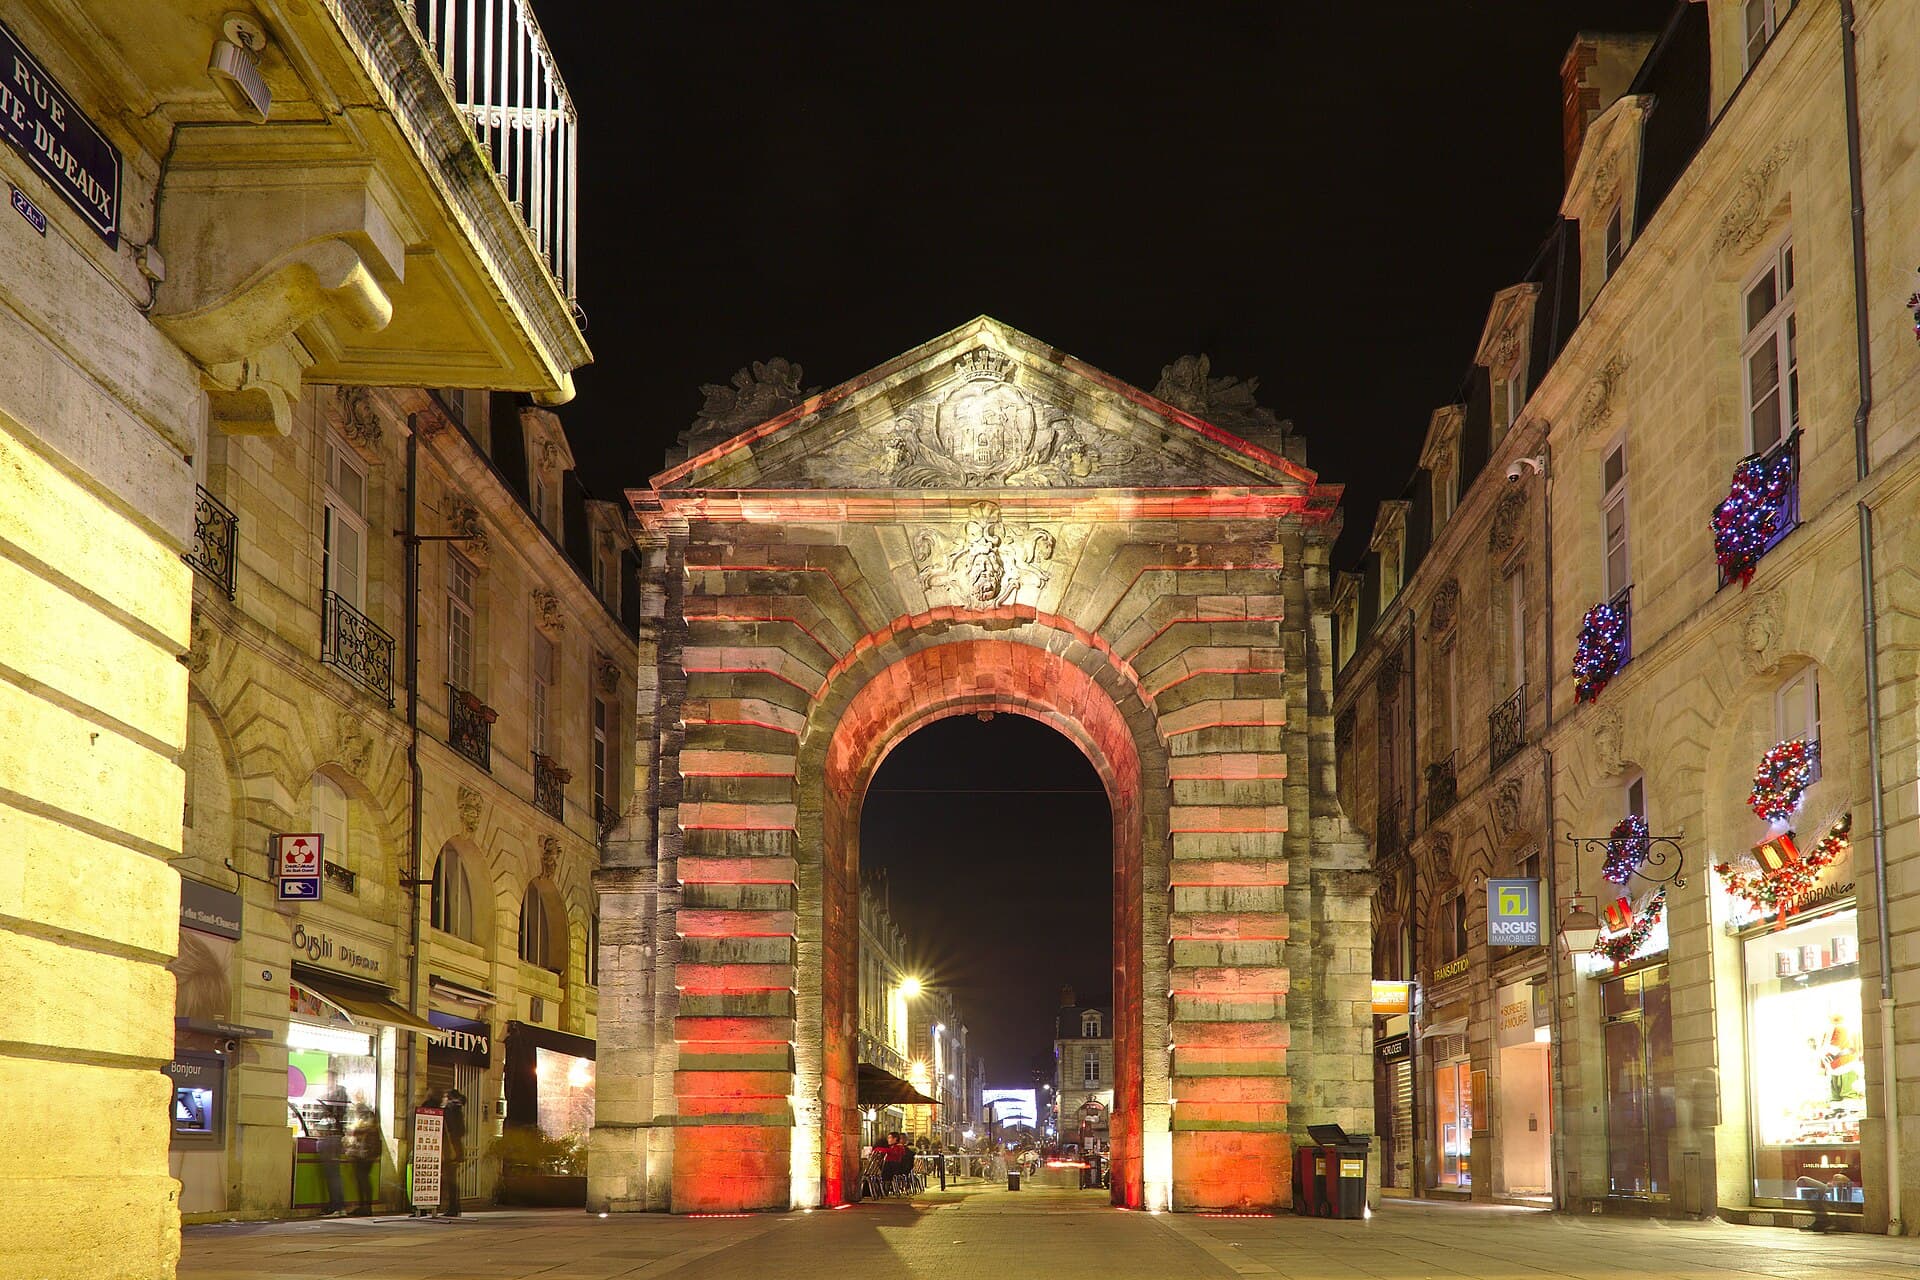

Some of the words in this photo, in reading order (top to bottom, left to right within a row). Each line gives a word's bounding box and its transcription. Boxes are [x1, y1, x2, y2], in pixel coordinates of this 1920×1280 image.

[14, 55, 65, 132] RUE
[1491, 921, 1537, 934] ARGUS
[1492, 934, 1536, 943] IMMOBILIER
[293, 924, 333, 961] Sushi
[339, 945, 380, 972] Dijeaux
[171, 1061, 201, 1077] Bonjour
